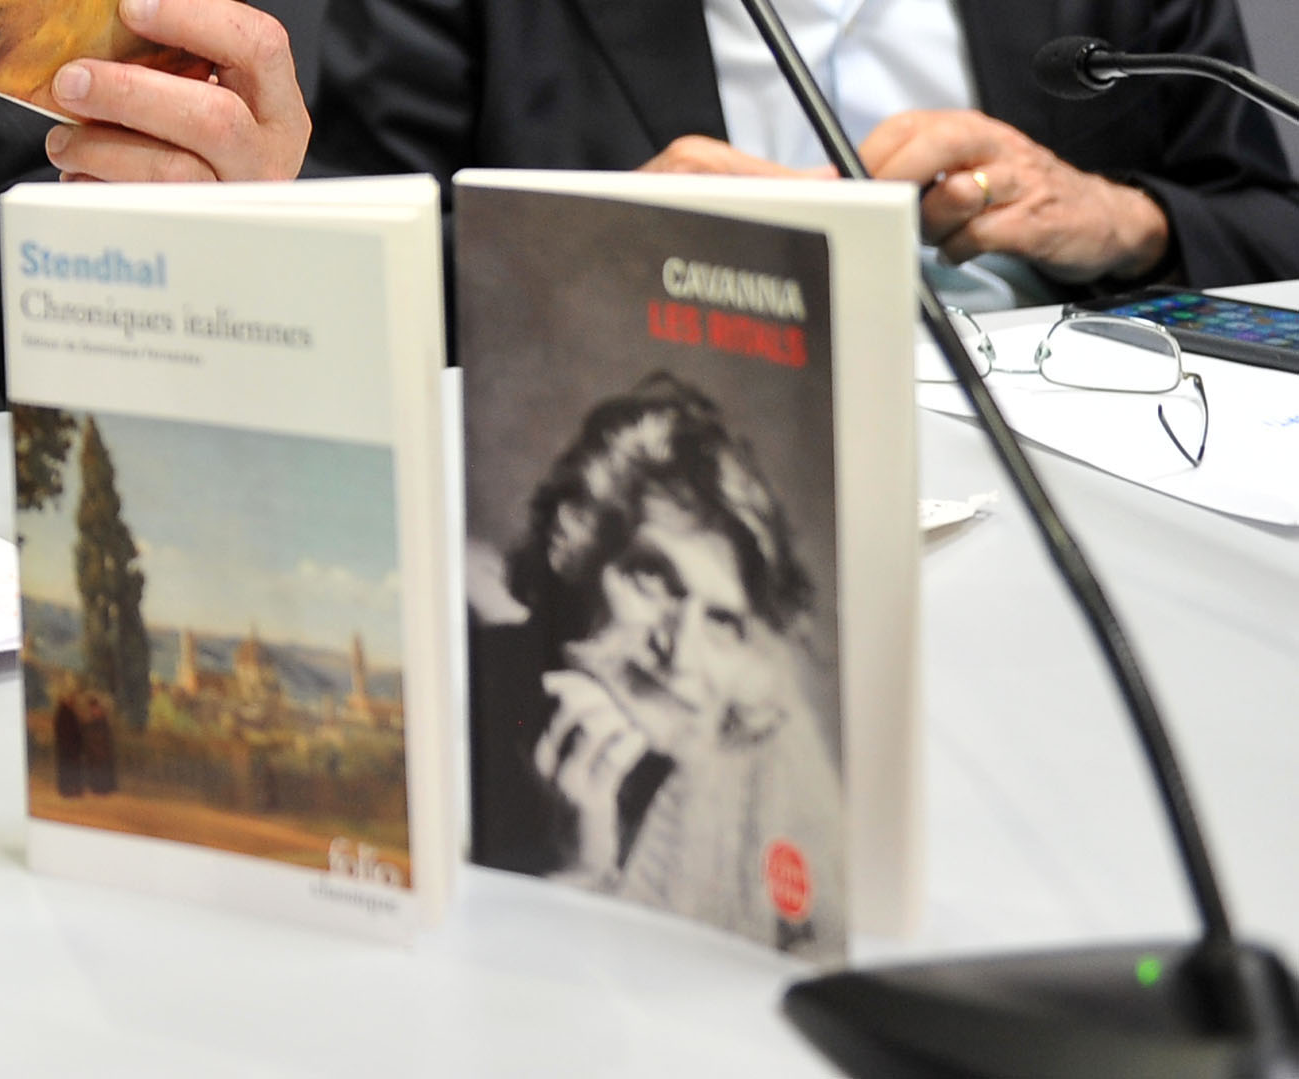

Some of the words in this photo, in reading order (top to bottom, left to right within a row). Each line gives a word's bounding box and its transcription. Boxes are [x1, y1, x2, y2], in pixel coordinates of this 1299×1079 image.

[20, 240, 167, 288] Stendhal
[662, 256, 807, 322] CAVANNA
[19, 287, 174, 336] Chroniques
[182, 301, 314, 349] italiennes
[648, 299, 702, 345] LES
